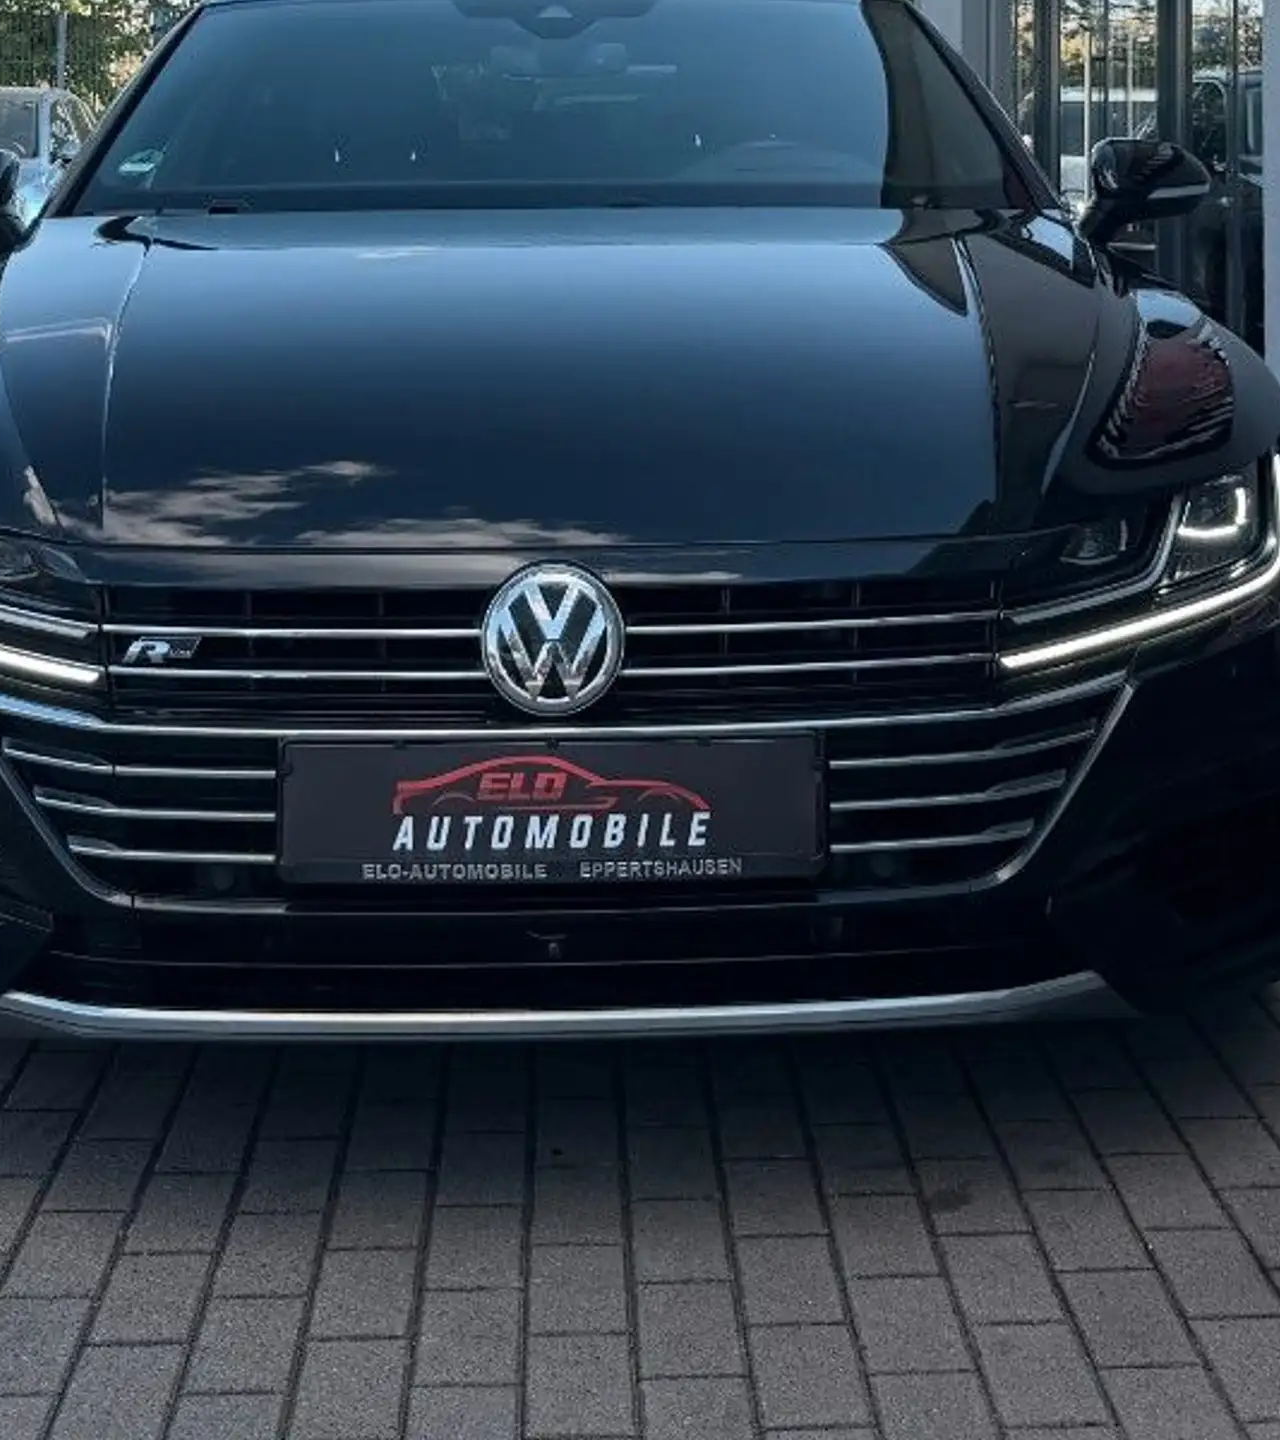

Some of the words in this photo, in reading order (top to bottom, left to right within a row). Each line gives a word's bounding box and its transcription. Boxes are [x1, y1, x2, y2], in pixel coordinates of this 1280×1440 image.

[476, 772, 567, 802] ELO
[392, 811, 711, 852] AUTOMOBILE
[362, 863, 548, 881] ELO-AUTOMOBILE
[579, 858, 742, 879] EPPERTSHAUSEN
